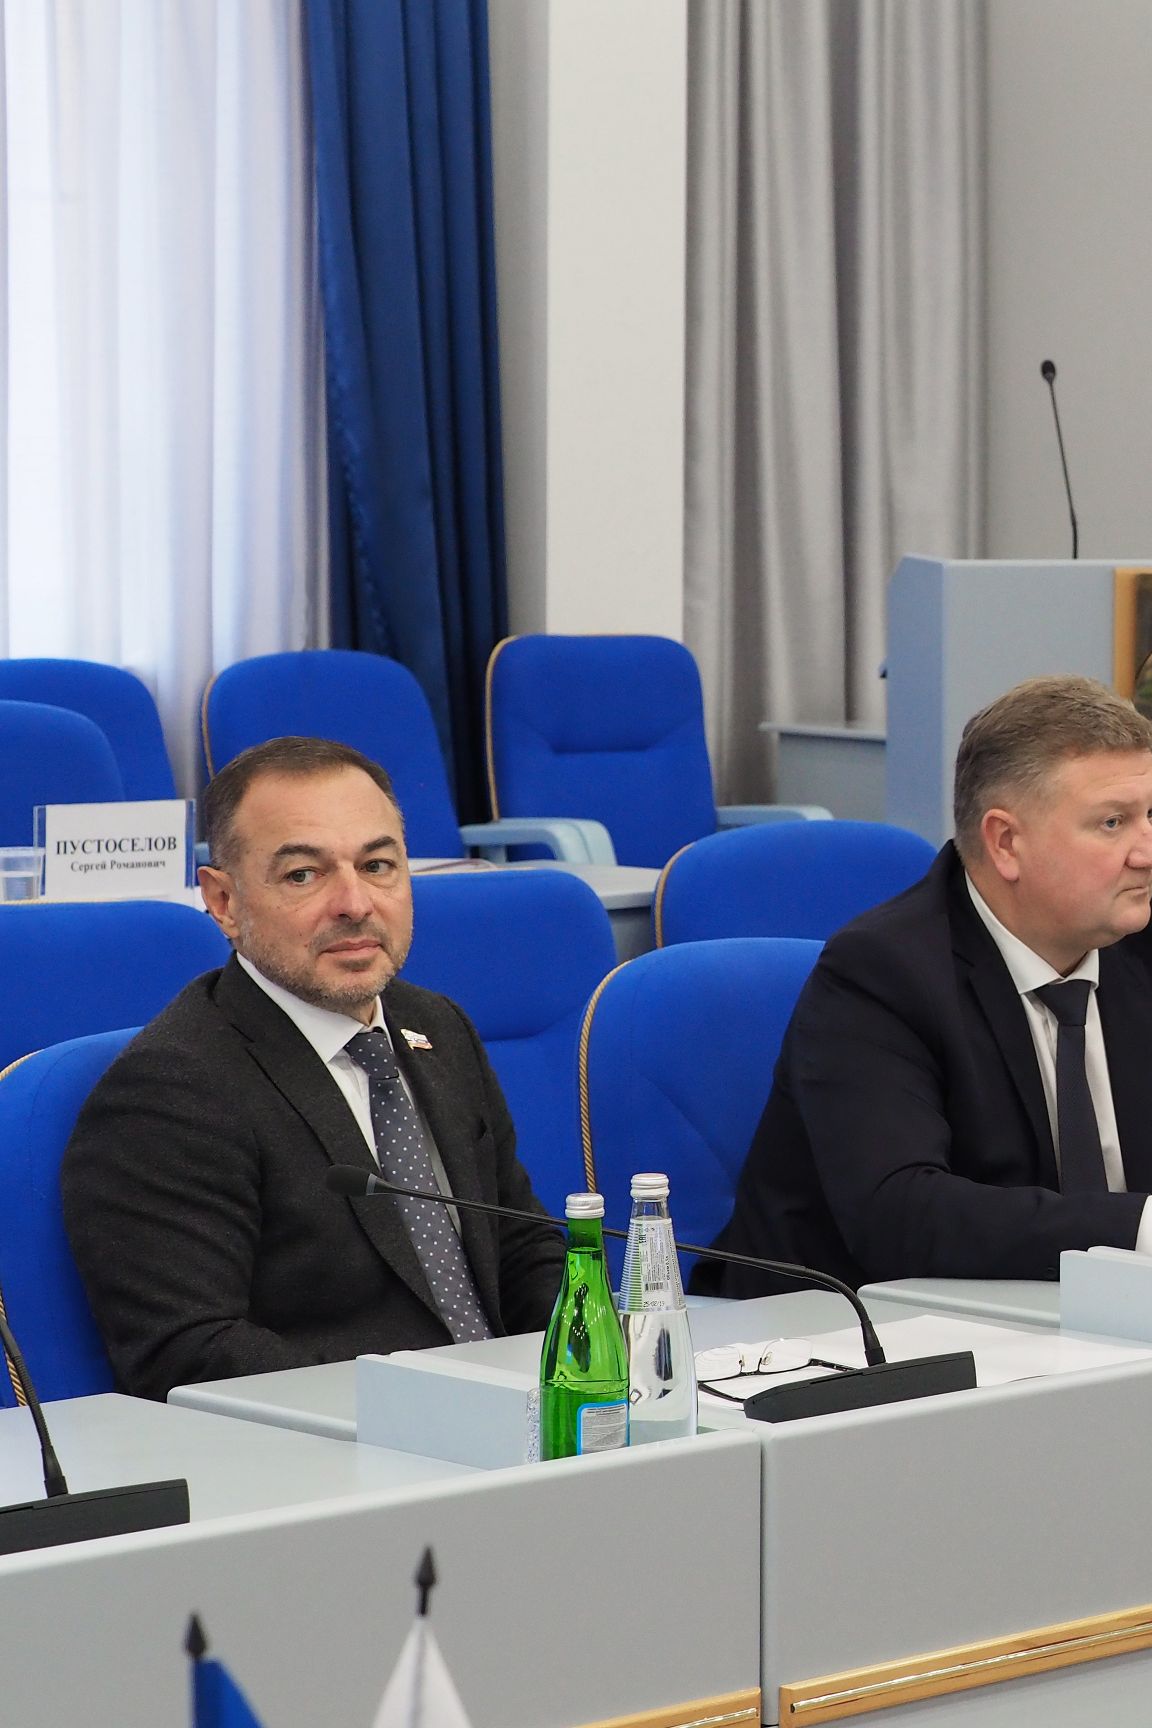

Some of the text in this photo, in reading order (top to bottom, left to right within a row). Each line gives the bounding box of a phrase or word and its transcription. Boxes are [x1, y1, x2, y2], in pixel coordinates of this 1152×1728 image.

[56, 836, 177, 855] ПУСТОСЕЛОВ
[70, 860, 166, 874] Сергей Романович
